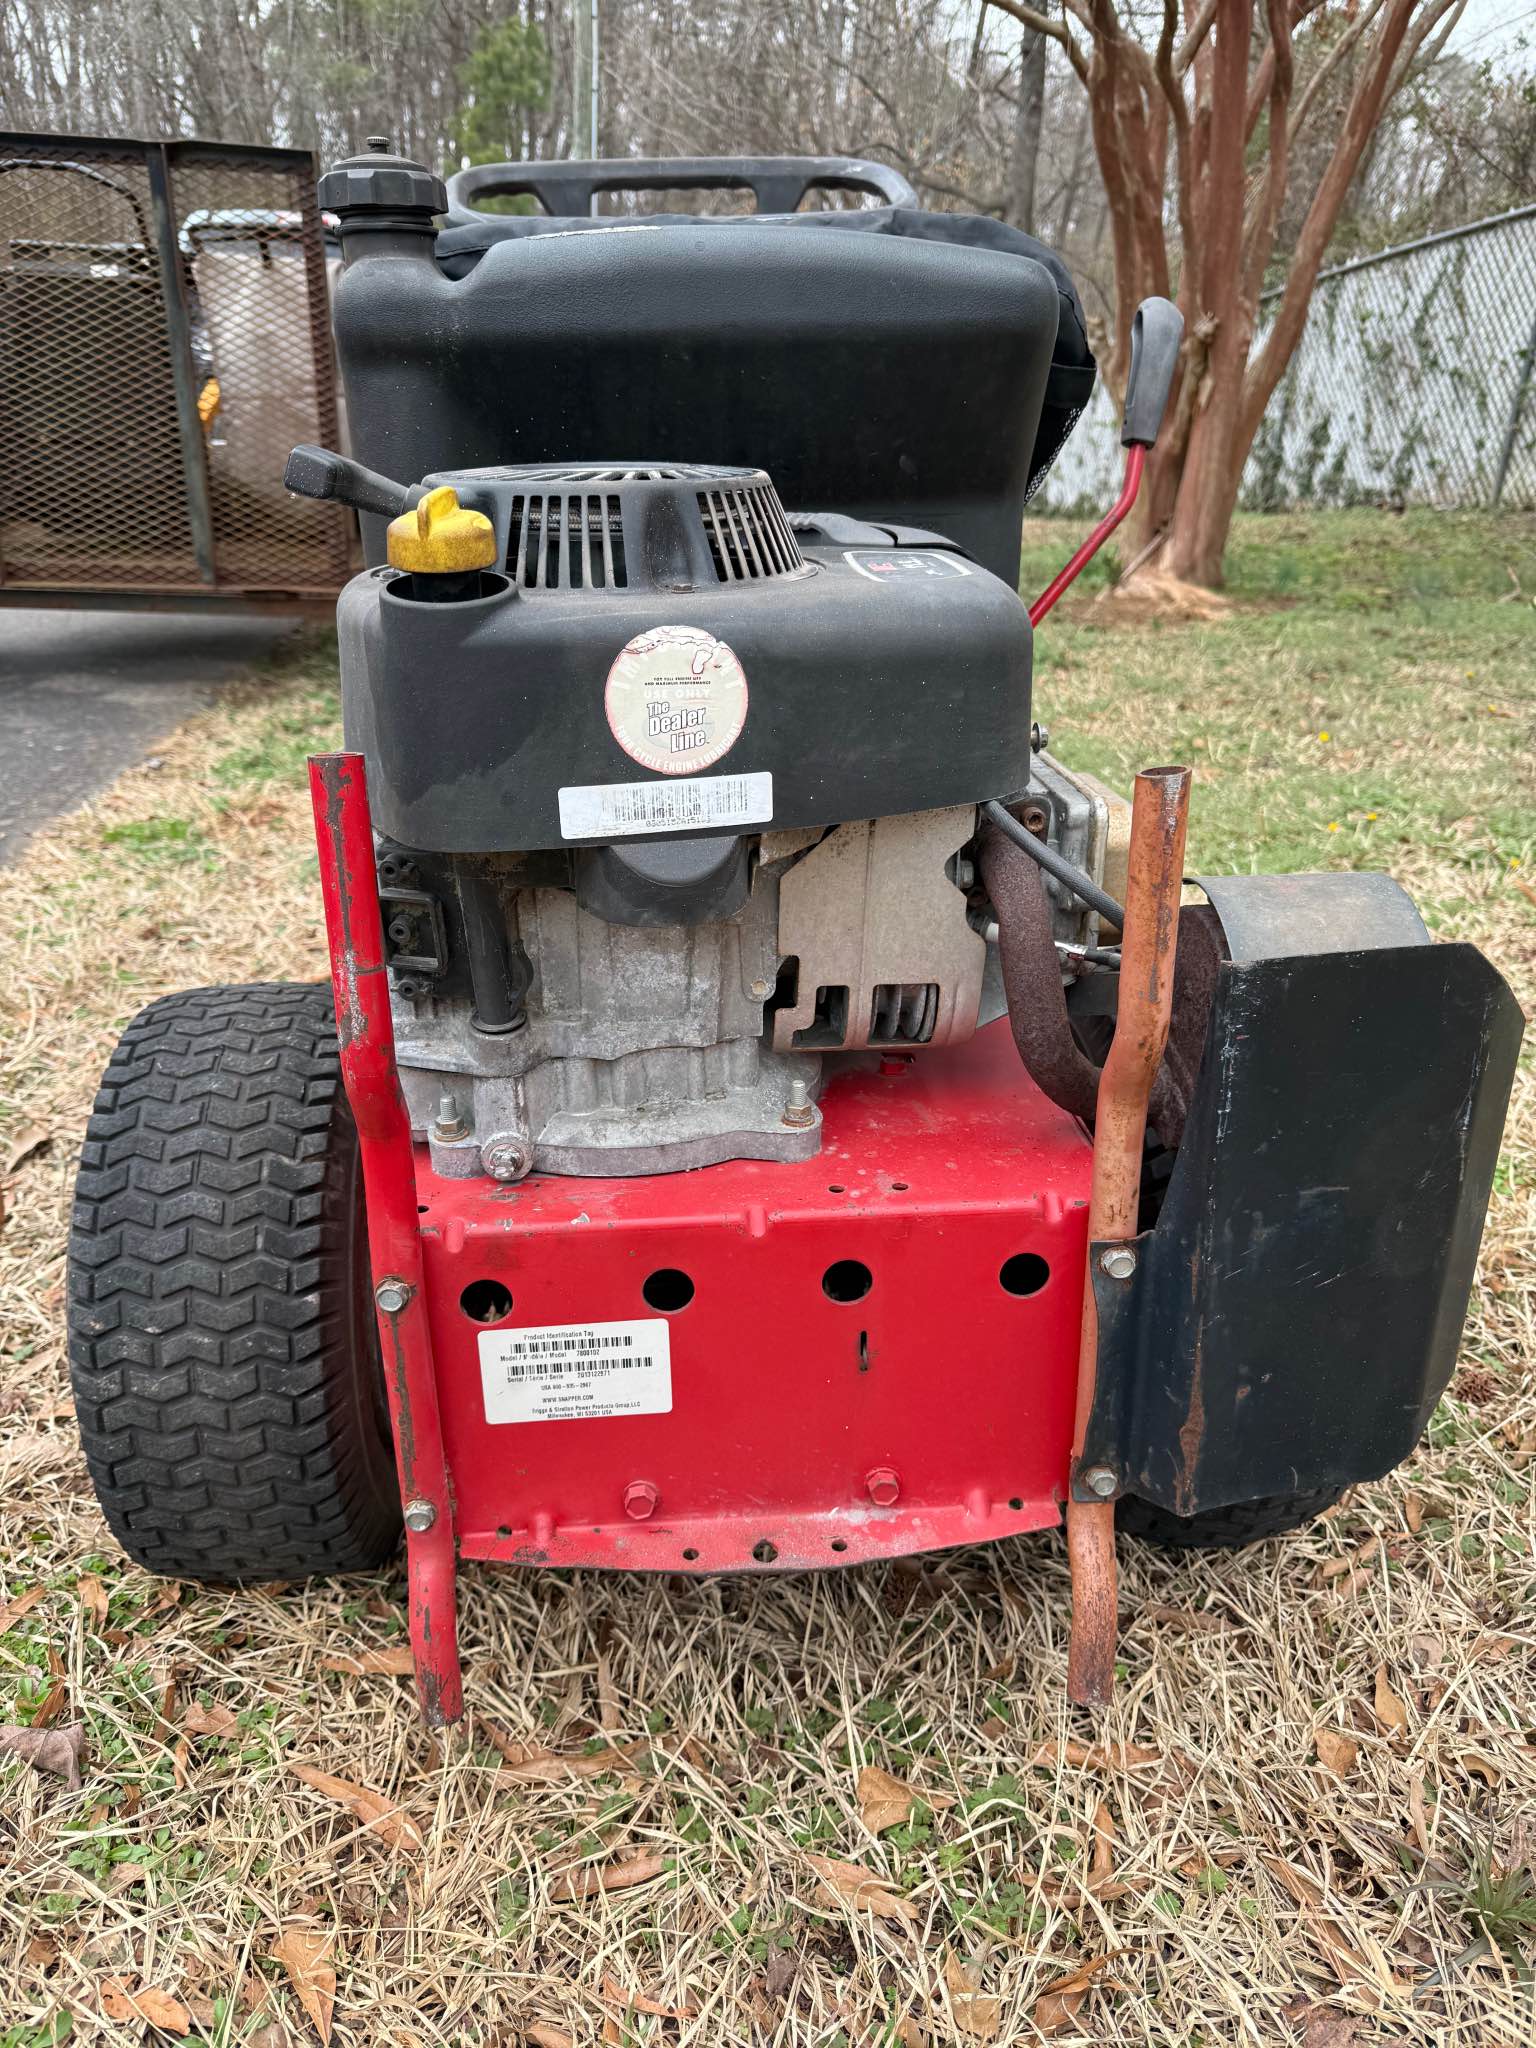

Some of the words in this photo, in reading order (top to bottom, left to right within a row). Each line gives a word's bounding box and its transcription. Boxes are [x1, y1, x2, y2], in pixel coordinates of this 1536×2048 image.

[647, 701, 670, 716] The
[649, 707, 707, 736] Dealer
[633, 747, 662, 769] CYCLE
[664, 759, 699, 772] ENGINE
[700, 720, 742, 766] LUBRICANT
[670, 730, 706, 753] Line
